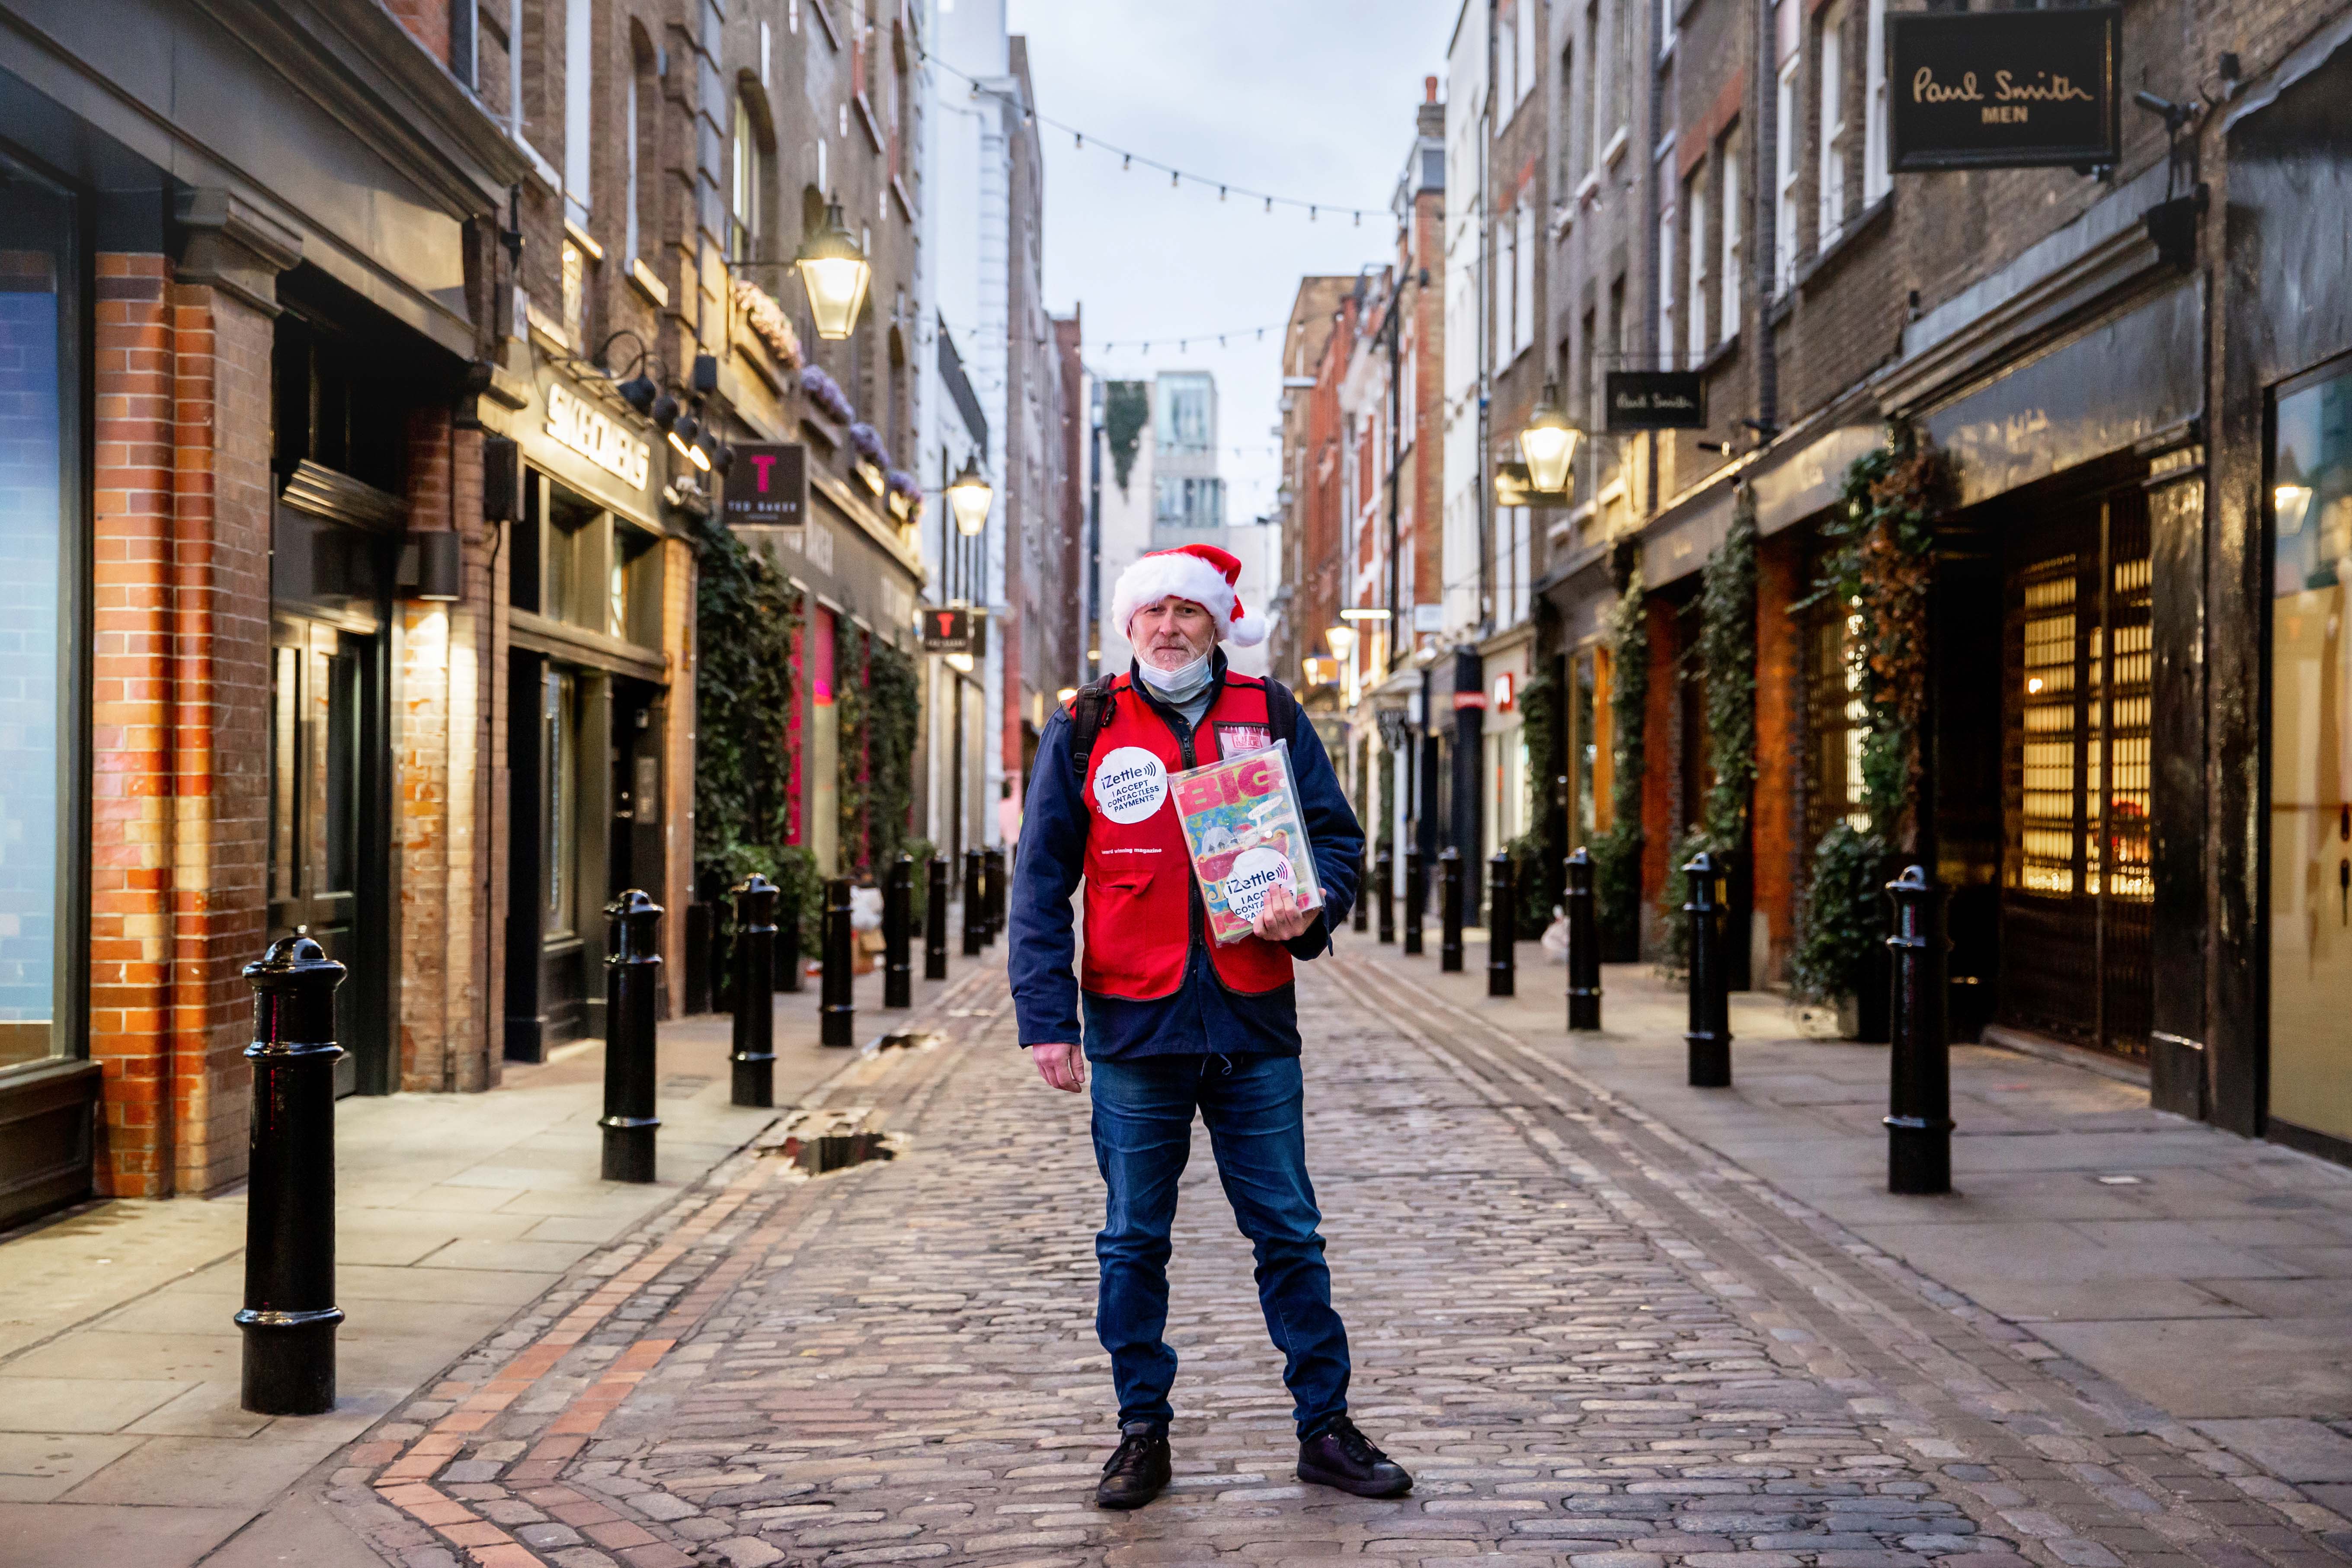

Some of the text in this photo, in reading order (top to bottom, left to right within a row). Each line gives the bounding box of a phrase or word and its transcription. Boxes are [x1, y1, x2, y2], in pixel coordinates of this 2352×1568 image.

[1913, 66, 2094, 103] Paul Smith
[1981, 106, 2028, 124] MEN
[751, 455, 776, 492] T
[937, 612, 954, 637] T
[1101, 768, 1142, 790] iZettle
[1117, 780, 1148, 796] ACCEPT
[1178, 760, 1288, 817] BIG
[1108, 785, 1159, 807] CONTACTLESS
[1114, 794, 1154, 812] PAYMENTS
[1226, 870, 1276, 894] iZettle
